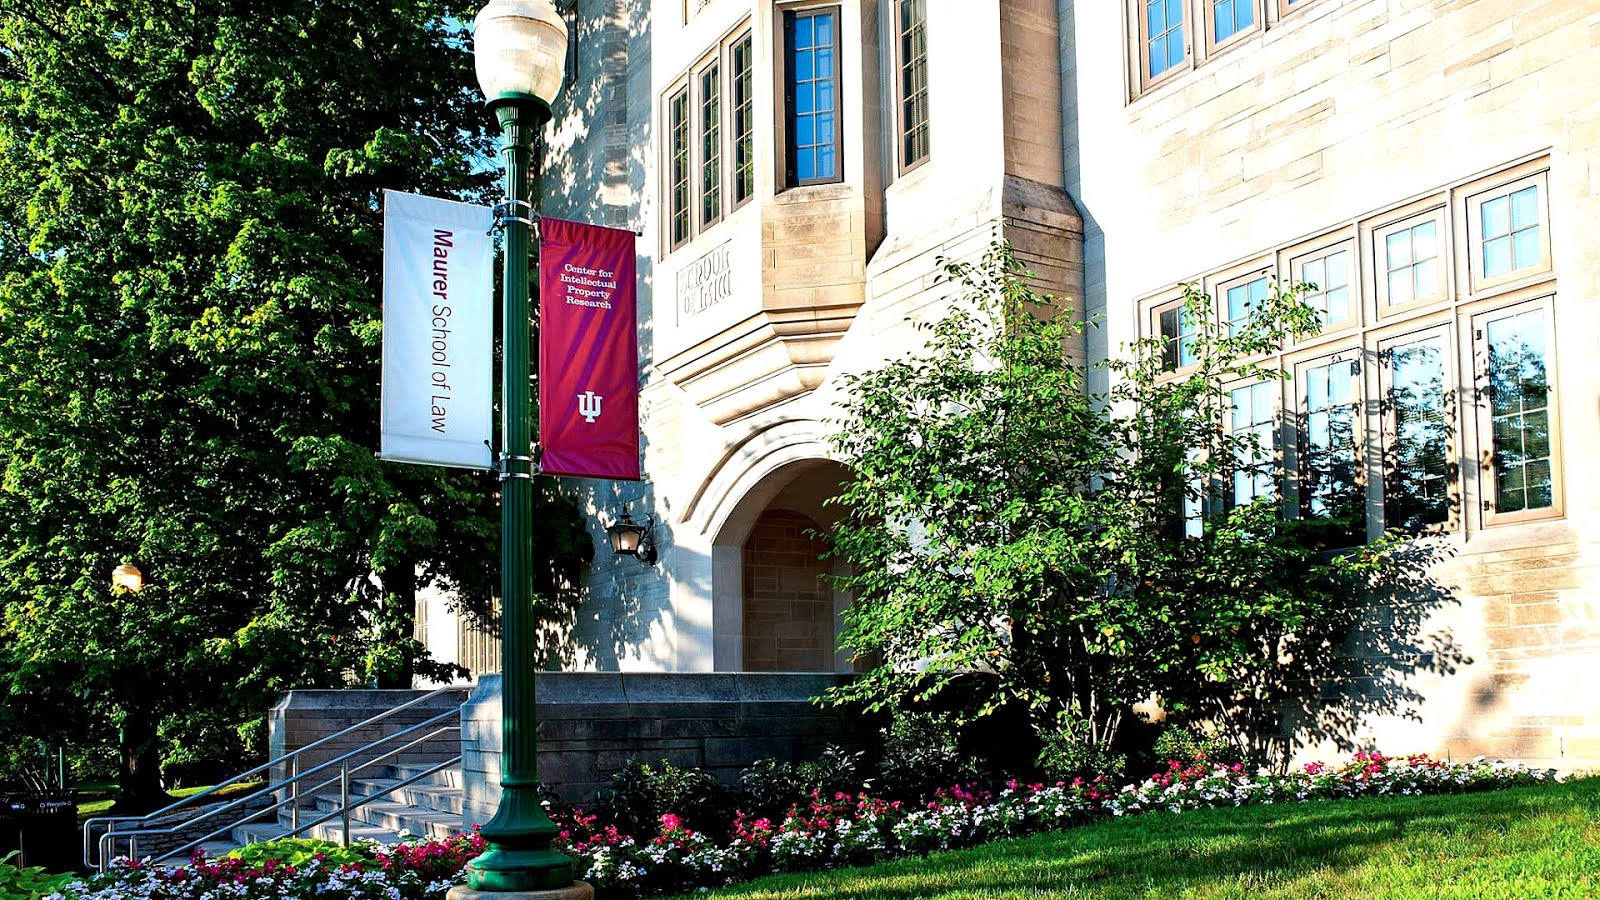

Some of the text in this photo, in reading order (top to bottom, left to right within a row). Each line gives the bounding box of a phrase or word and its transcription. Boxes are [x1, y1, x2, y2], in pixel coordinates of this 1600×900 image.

[564, 263, 613, 278] Center for
[560, 273, 617, 289] Intellectual
[567, 285, 611, 300] Property
[565, 295, 612, 309] Research
[431, 229, 453, 433] Maurer School of Law
